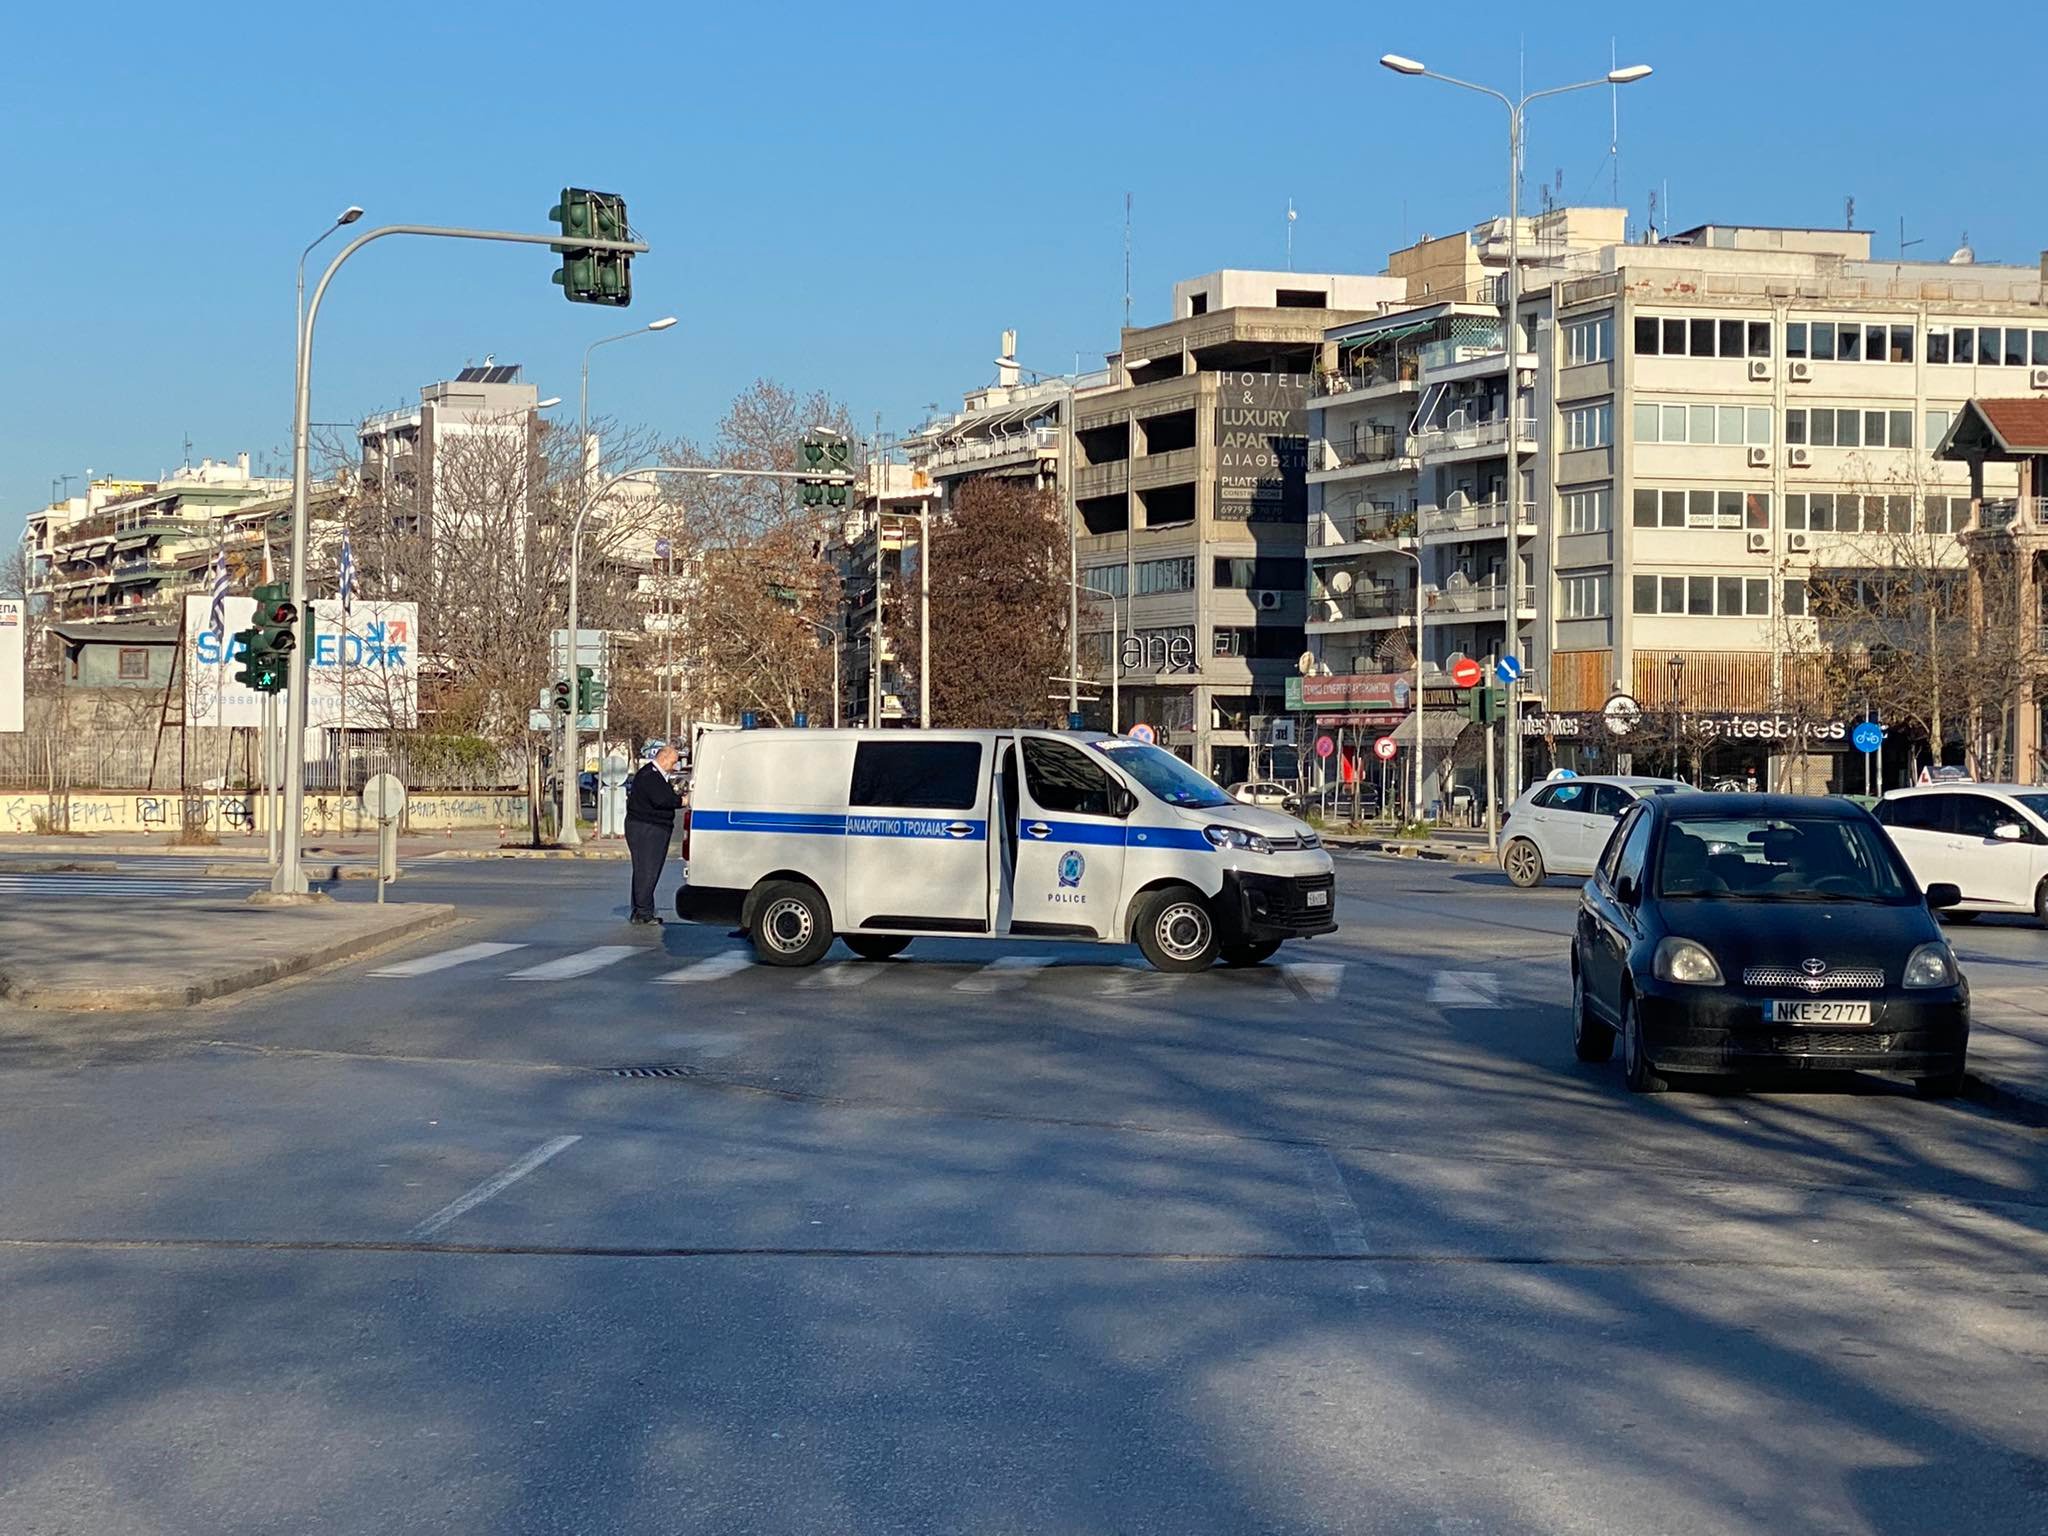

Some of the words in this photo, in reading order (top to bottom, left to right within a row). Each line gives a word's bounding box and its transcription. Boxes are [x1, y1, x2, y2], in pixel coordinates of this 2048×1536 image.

[1222, 372, 1304, 388] HOTEL
[1242, 390, 1254, 404] &
[1222, 408, 1290, 427] LUXURY
[197, 631, 363, 666] SAED
[1122, 624, 1201, 669] anel
[848, 818, 900, 834] ΑΝΑΚΡΙΤΙΚΟ
[902, 820, 948, 836] ΤΡΟΧΑΙΑΣ
[1047, 893, 1087, 904] POLICE
[1777, 1002, 1867, 1021] NKE-2777
